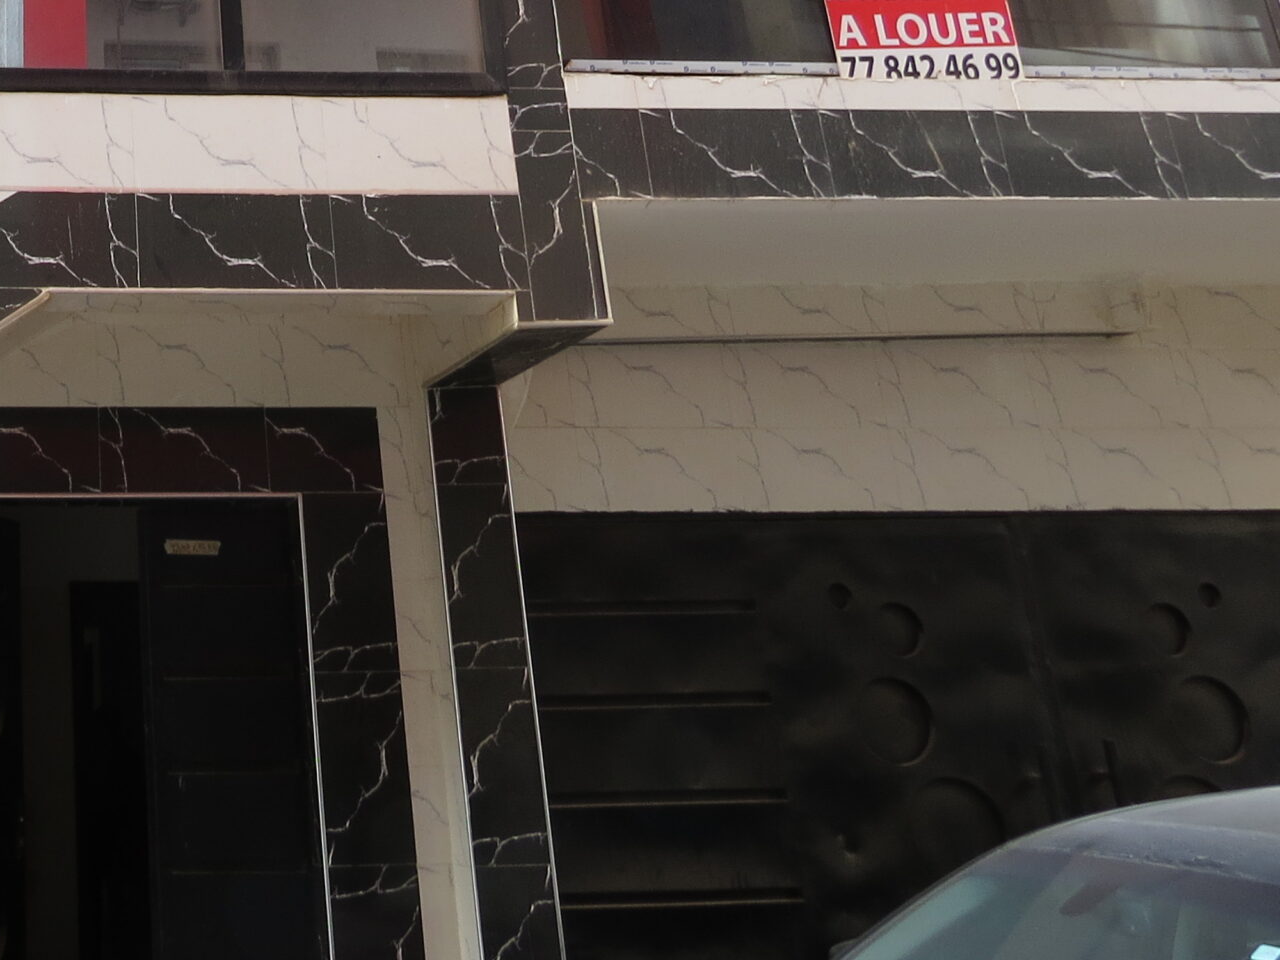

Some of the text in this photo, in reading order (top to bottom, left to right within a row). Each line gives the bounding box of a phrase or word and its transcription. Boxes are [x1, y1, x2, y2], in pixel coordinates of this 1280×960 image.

[839, 12, 1010, 47] A LOUER
[840, 56, 874, 79] 77
[945, 53, 980, 79] 46
[984, 52, 1020, 79] 99
